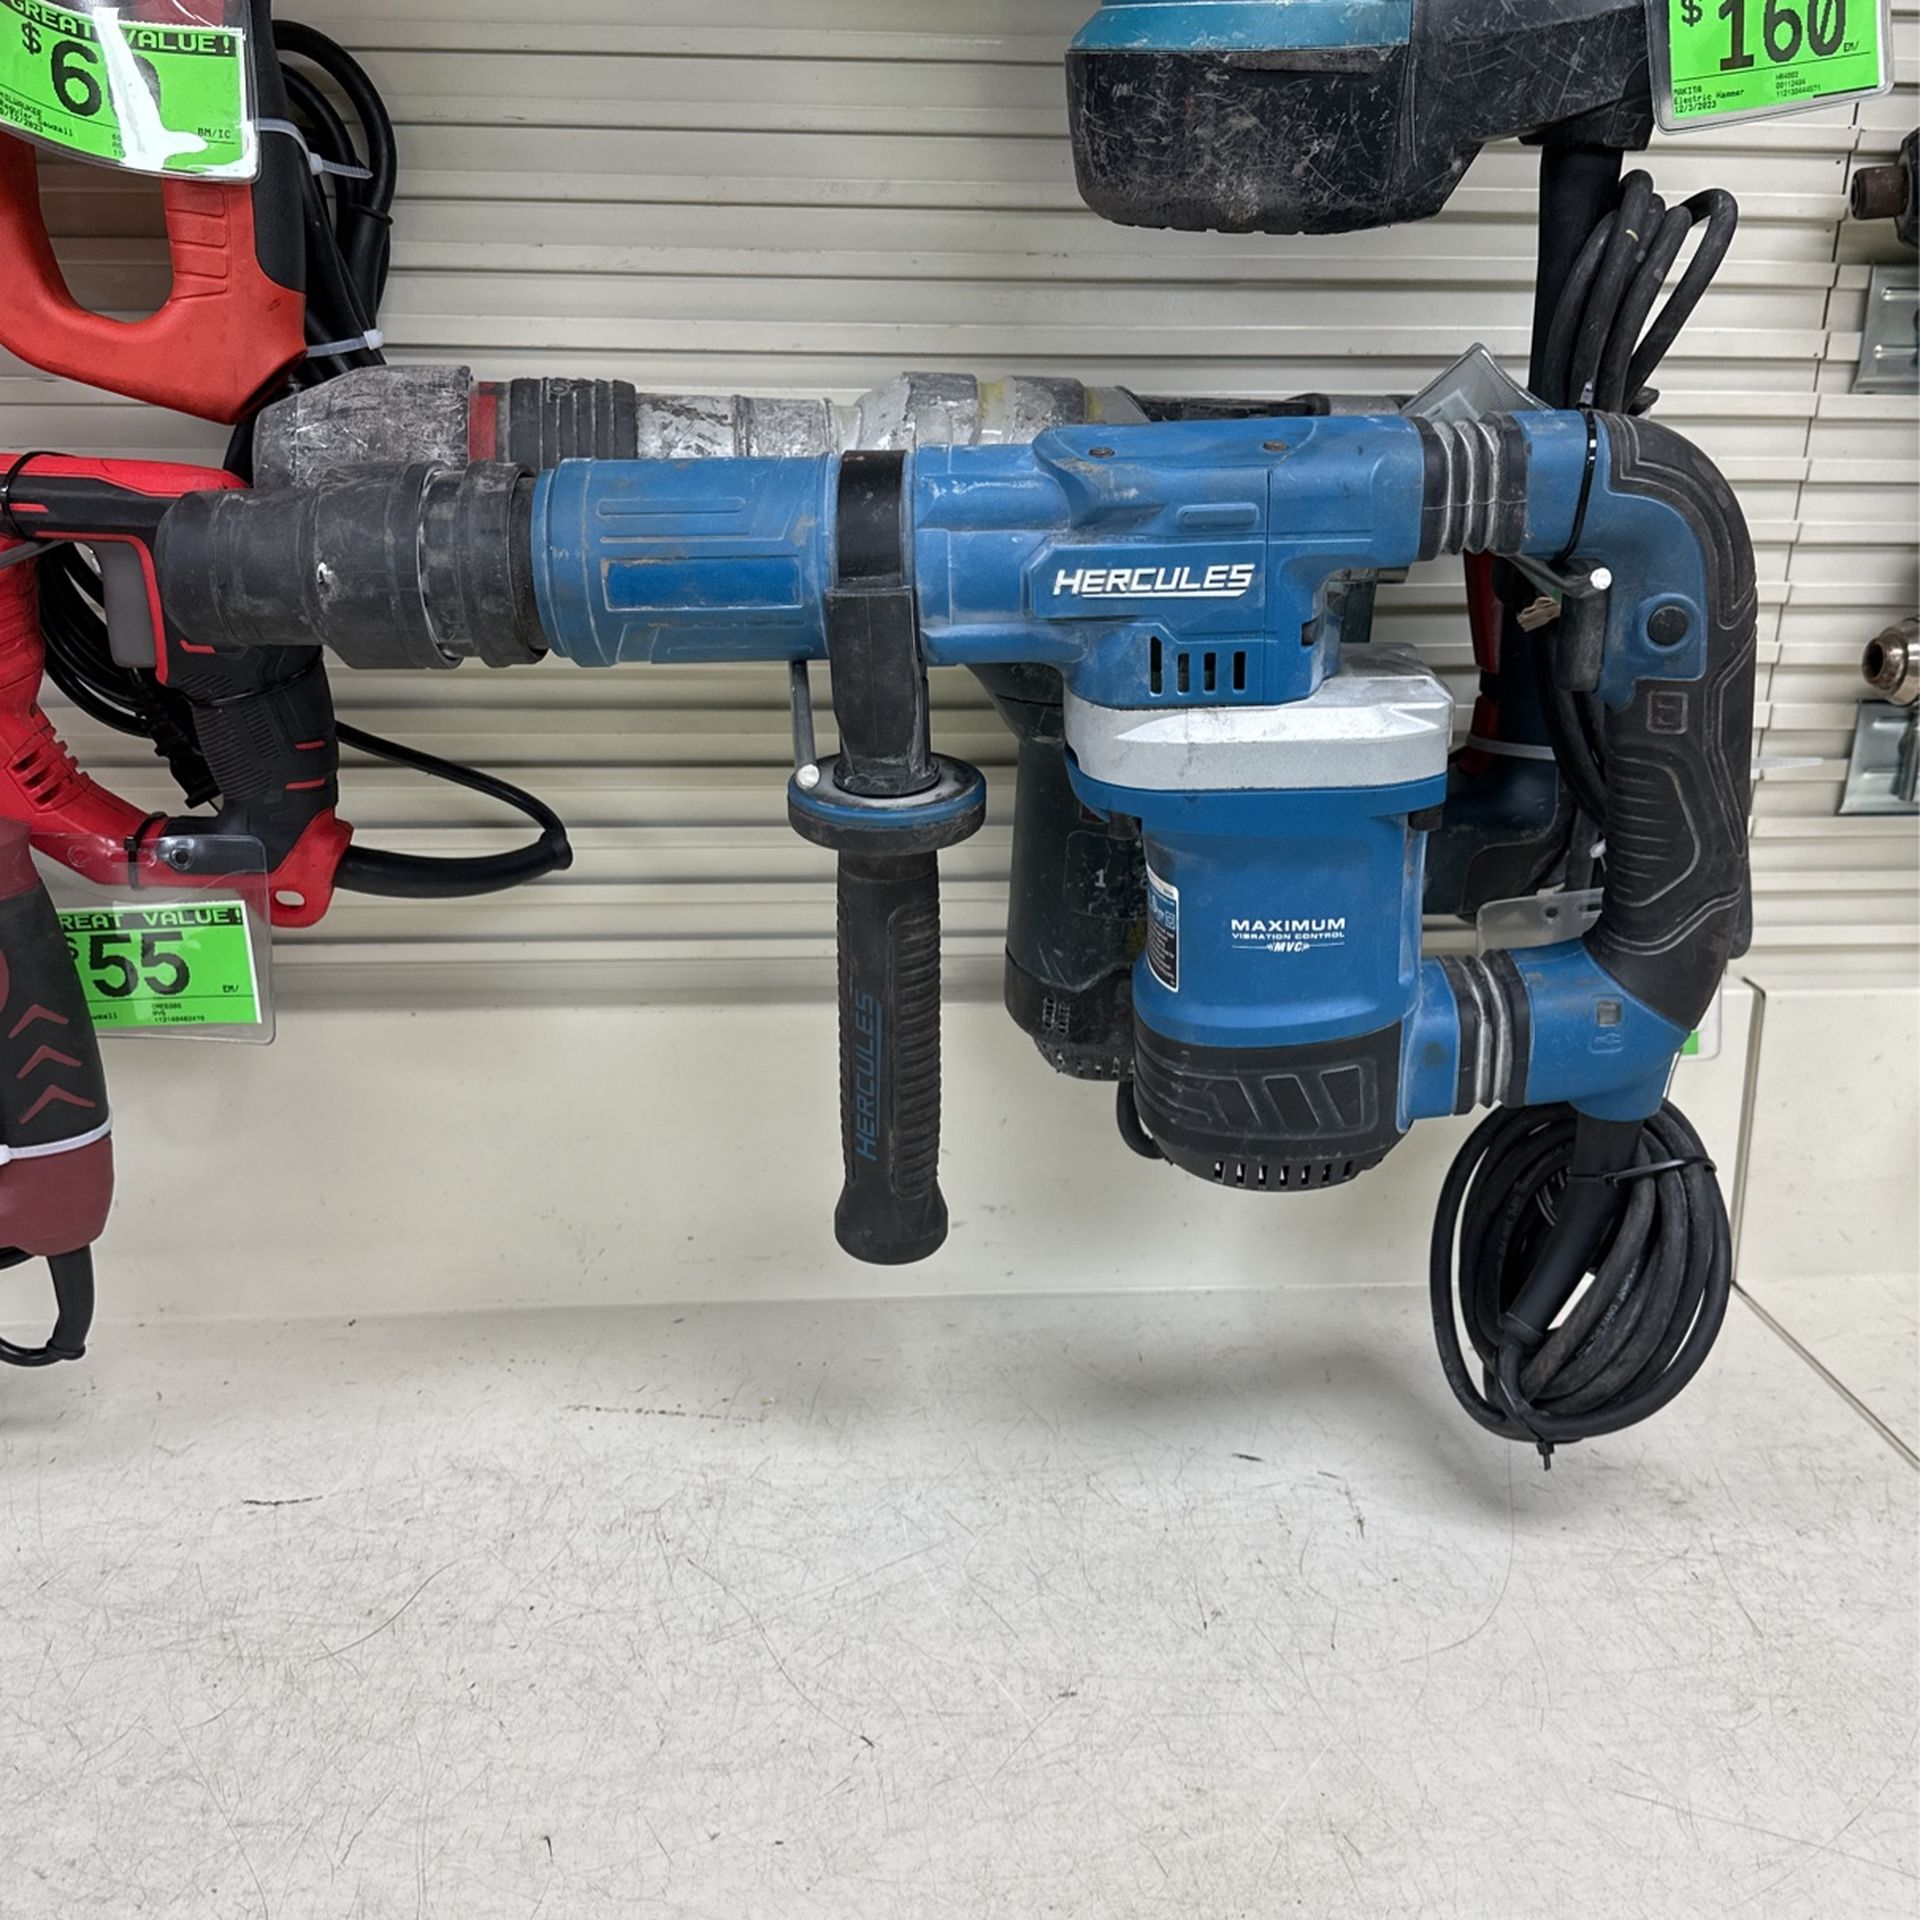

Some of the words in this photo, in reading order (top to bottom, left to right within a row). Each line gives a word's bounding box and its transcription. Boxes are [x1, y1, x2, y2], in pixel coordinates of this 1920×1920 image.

[11, 0, 95, 38] GREAT
[1053, 563, 1256, 597] HERCULES
[60, 913, 124, 930] REAT
[143, 907, 241, 925] VALUE!
[1231, 917, 1346, 932] MAXIMUM
[1232, 932, 1291, 940] VIBRATION
[1295, 931, 1345, 940] CONTROL
[856, 989, 881, 1161] HERCULES
